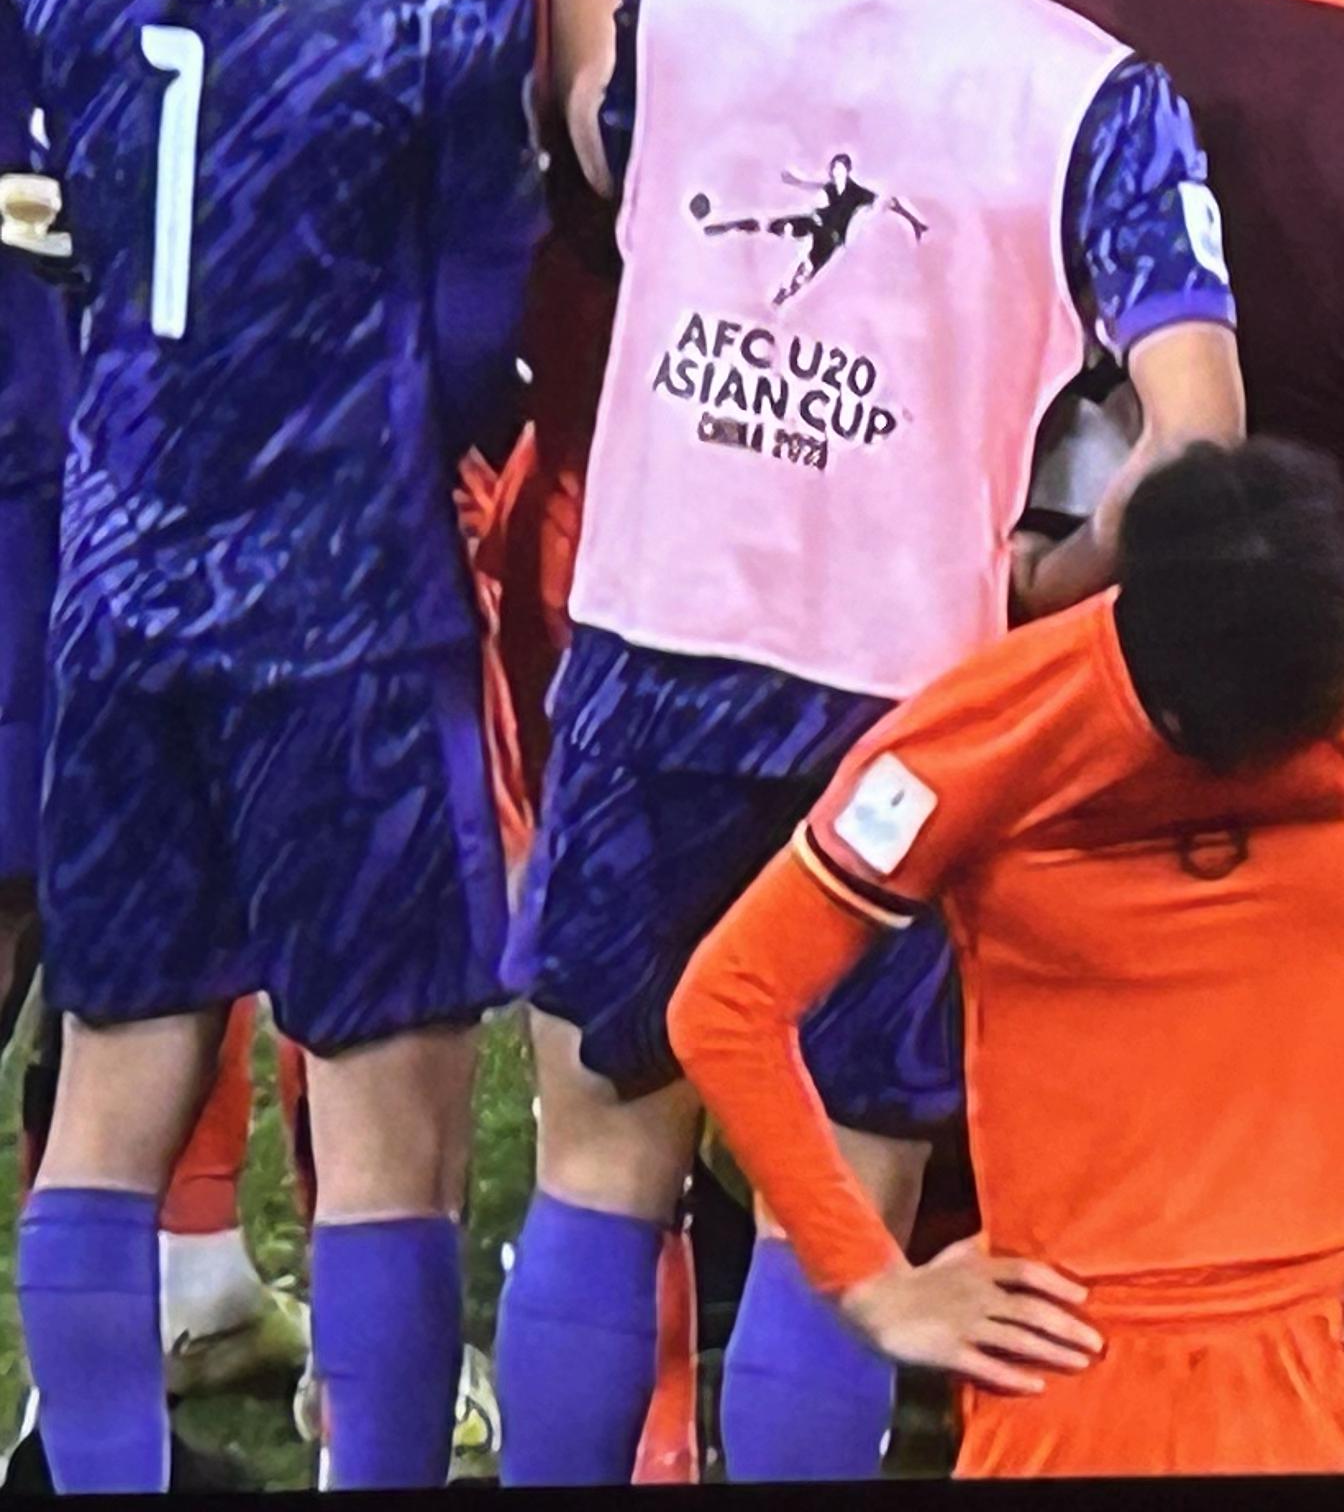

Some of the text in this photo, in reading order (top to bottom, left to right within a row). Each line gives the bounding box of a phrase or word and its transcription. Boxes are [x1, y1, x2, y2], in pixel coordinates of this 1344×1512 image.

[140, 23, 205, 340] 1
[652, 350, 789, 421] ASIAN
[799, 389, 897, 445] CUP
[677, 312, 877, 398] AFC U20
